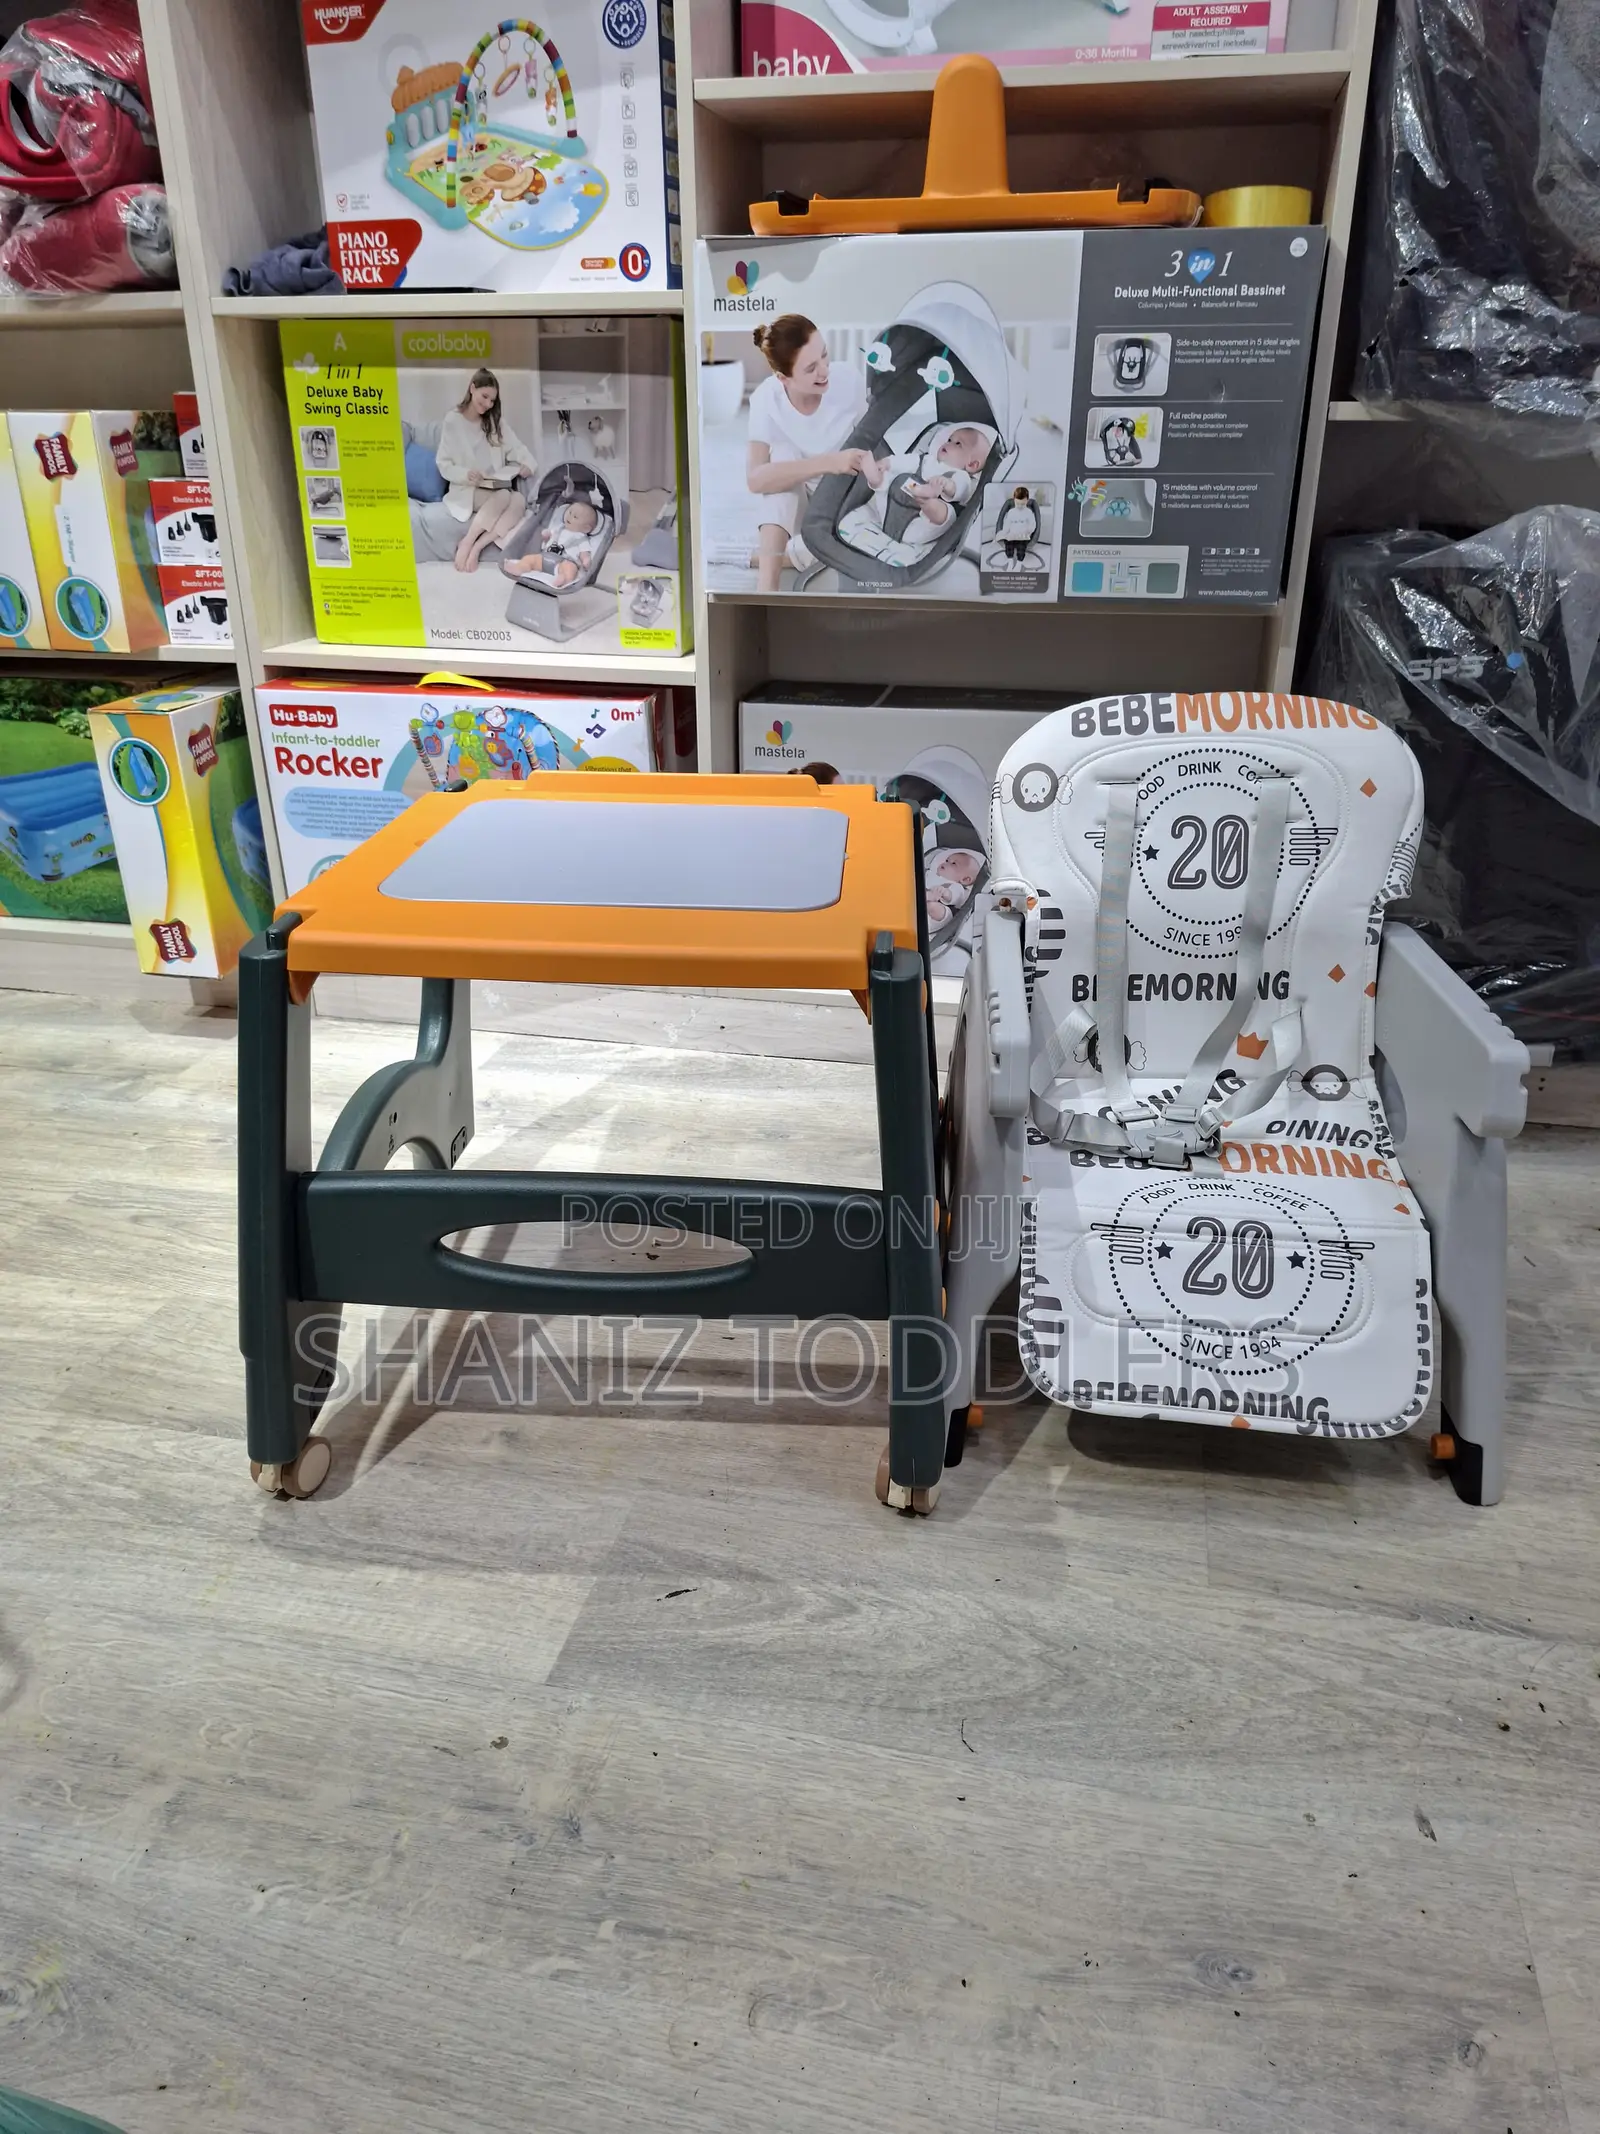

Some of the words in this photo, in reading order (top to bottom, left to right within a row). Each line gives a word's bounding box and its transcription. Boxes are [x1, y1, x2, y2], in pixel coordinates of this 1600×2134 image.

[314, 5, 362, 20] HUANGER
[1173, 7, 1201, 17] ADULT
[1204, 5, 1248, 15] ASSEMBLY
[1190, 17, 1232, 27] REQUIRED
[1101, 46, 1137, 58] Months
[338, 231, 388, 249] PIANO
[340, 248, 400, 266] FITNESS
[1164, 250, 1184, 277] 3
[1189, 255, 1215, 275] in
[1219, 251, 1233, 277] 1
[342, 266, 383, 284] RACK
[1114, 286, 1149, 298] Deluxe
[1152, 284, 1238, 298] Multi-Functional
[1241, 284, 1286, 296] Bassinet
[713, 296, 775, 311] mastela
[408, 332, 486, 356] coolbaby
[1176, 338, 1214, 347] Side-to-side
[1215, 338, 1249, 347] movement
[1250, 338, 1256, 346] in
[1257, 338, 1262, 346] 5
[1263, 338, 1279, 346] ideal
[1279, 338, 1300, 348] angles
[336, 363, 350, 379] in
[306, 385, 348, 398] Deluxe
[353, 385, 383, 400] Baby
[304, 402, 341, 418] Swing
[346, 402, 389, 415] Classic
[1203, 412, 1228, 420] position
[49, 437, 69, 474] FAMILY
[113, 441, 133, 457] FAMILY
[173, 496, 194, 504] Electric
[430, 629, 462, 640] Model:
[466, 630, 512, 641] CB02003
[1070, 692, 1379, 738] BEBEMORNING
[191, 735, 212, 757] FAMILY
[271, 731, 381, 748] Infant-to-toddler
[754, 745, 805, 758] mastela
[274, 746, 384, 779] Rocker
[1137, 775, 1165, 801] OOD
[1177, 761, 1222, 777] DRINK
[1167, 814, 1249, 889] 20
[159, 926, 180, 959] FAMILY
[1163, 926, 1211, 946] SINCE
[1216, 925, 1242, 945] 199
[1265, 1119, 1373, 1148] DINING
[1140, 1187, 1175, 1204] FOOD
[1188, 1183, 1236, 1191] DRINK
[1253, 1187, 1309, 1211] COFFEE
[1182, 1216, 1275, 1300] 20
[1180, 1334, 1233, 1360] SINCE
[1240, 1335, 1282, 1360] 1994
